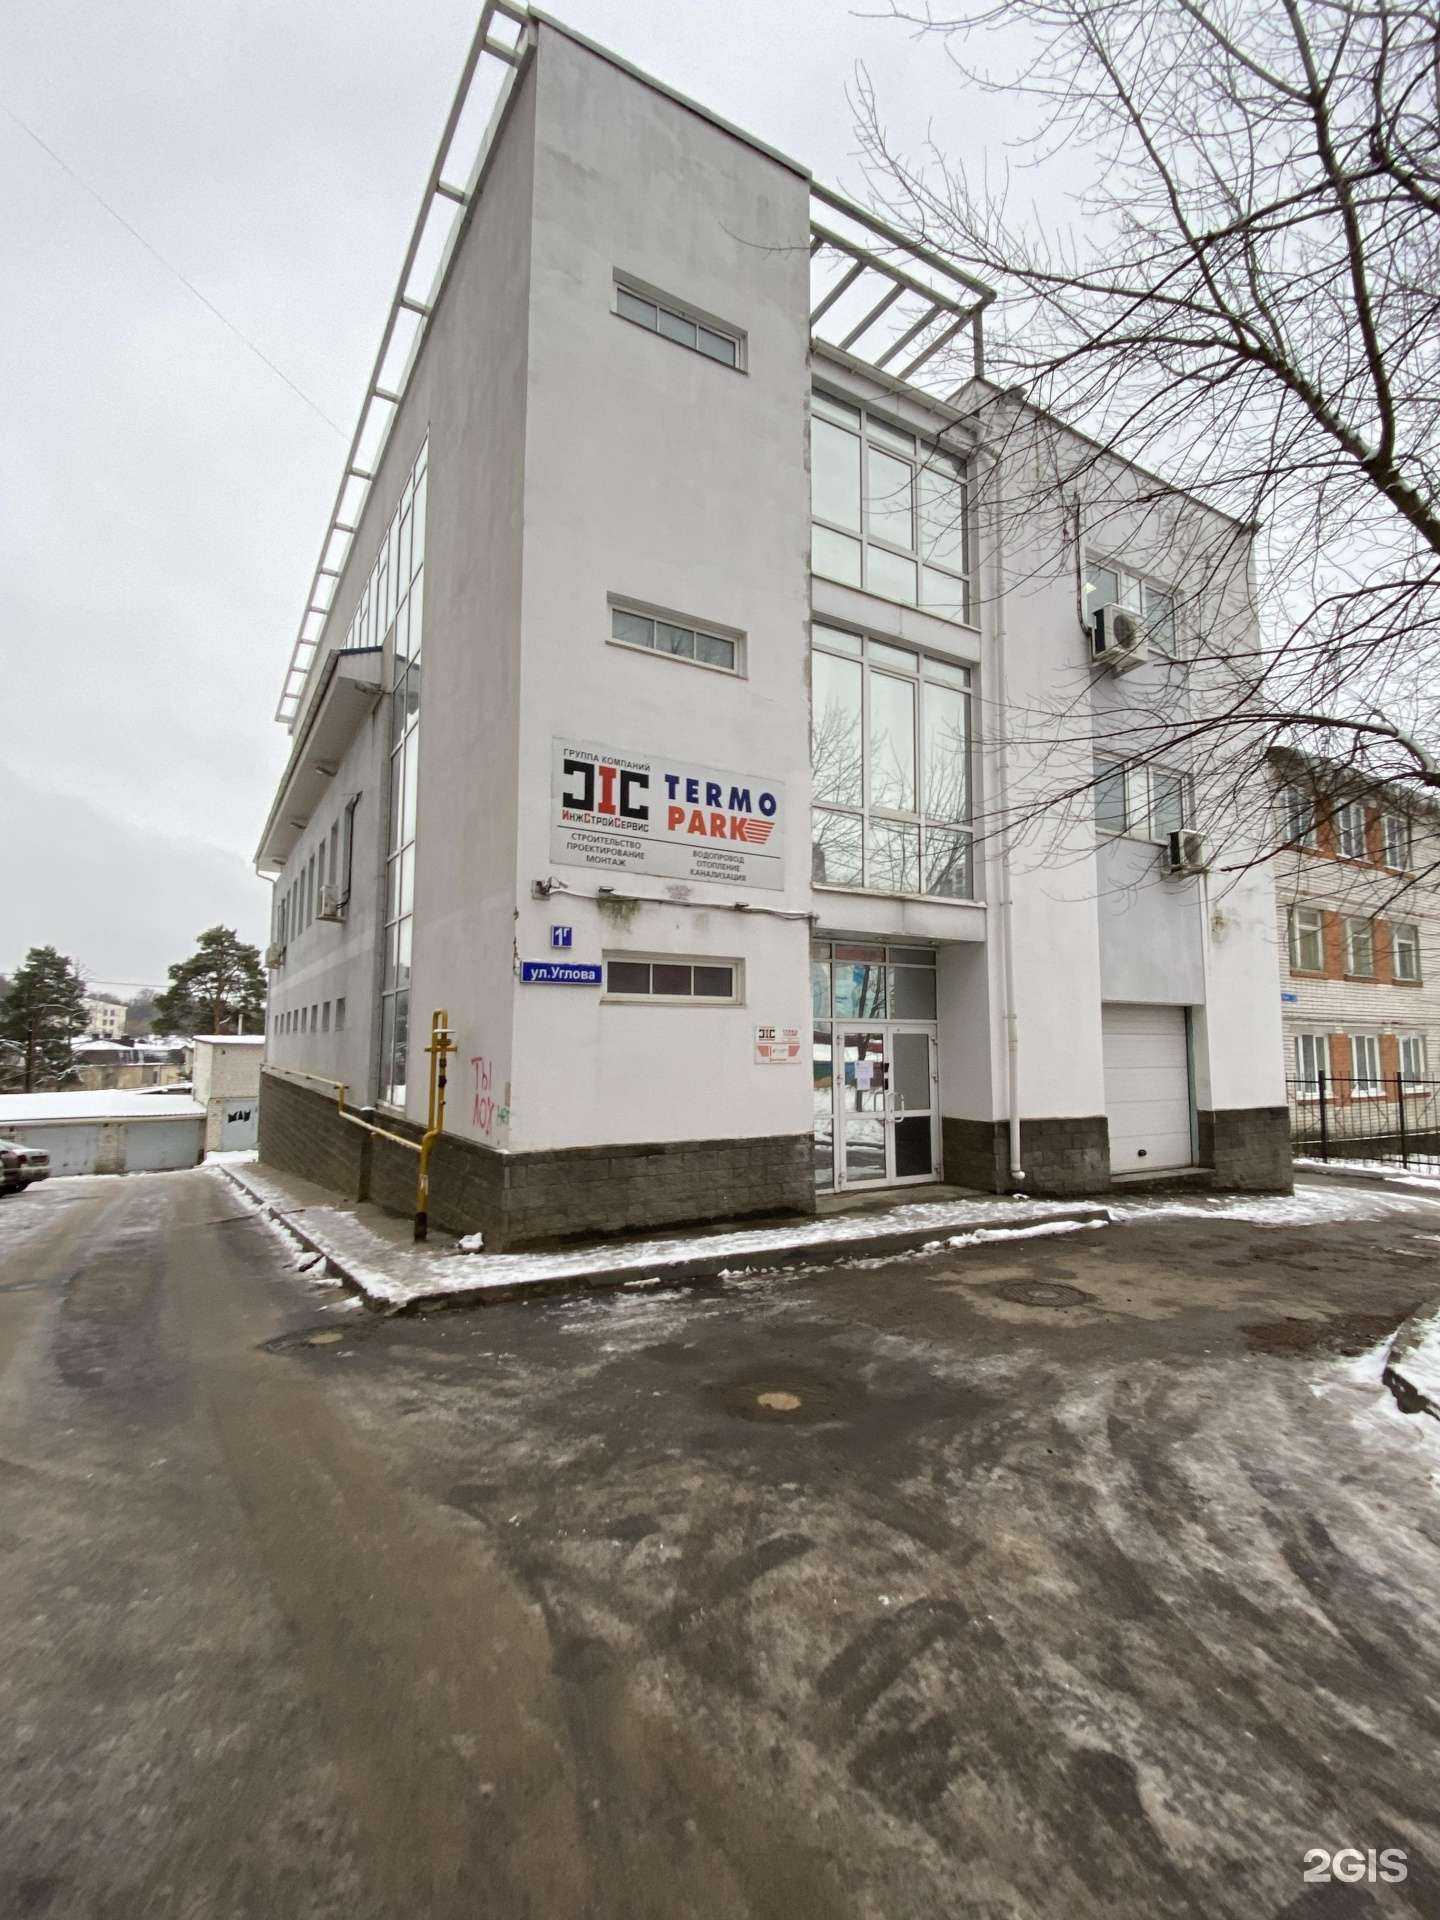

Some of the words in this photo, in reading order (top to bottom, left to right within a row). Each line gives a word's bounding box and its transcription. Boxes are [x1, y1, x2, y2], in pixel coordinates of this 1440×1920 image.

[563, 748, 600, 762] ГРУППА
[601, 756, 651, 772] КОМПАНИЙ
[664, 774, 777, 817] TERMO
[667, 805, 750, 842] PARK
[571, 832, 642, 850] СТРОИТЕЛЬСТВО
[566, 841, 645, 860] ПРОЕКТИРОВАНИЕ
[692, 850, 745, 864] ВОДОПРОВОД
[586, 854, 627, 867] МОНТАЖ
[696, 860, 740, 873] ОТОПЛЕНИЕ
[690, 868, 747, 882] КАНАЛИЗАЦИЯ
[530, 966, 596, 981] ул.Углова
